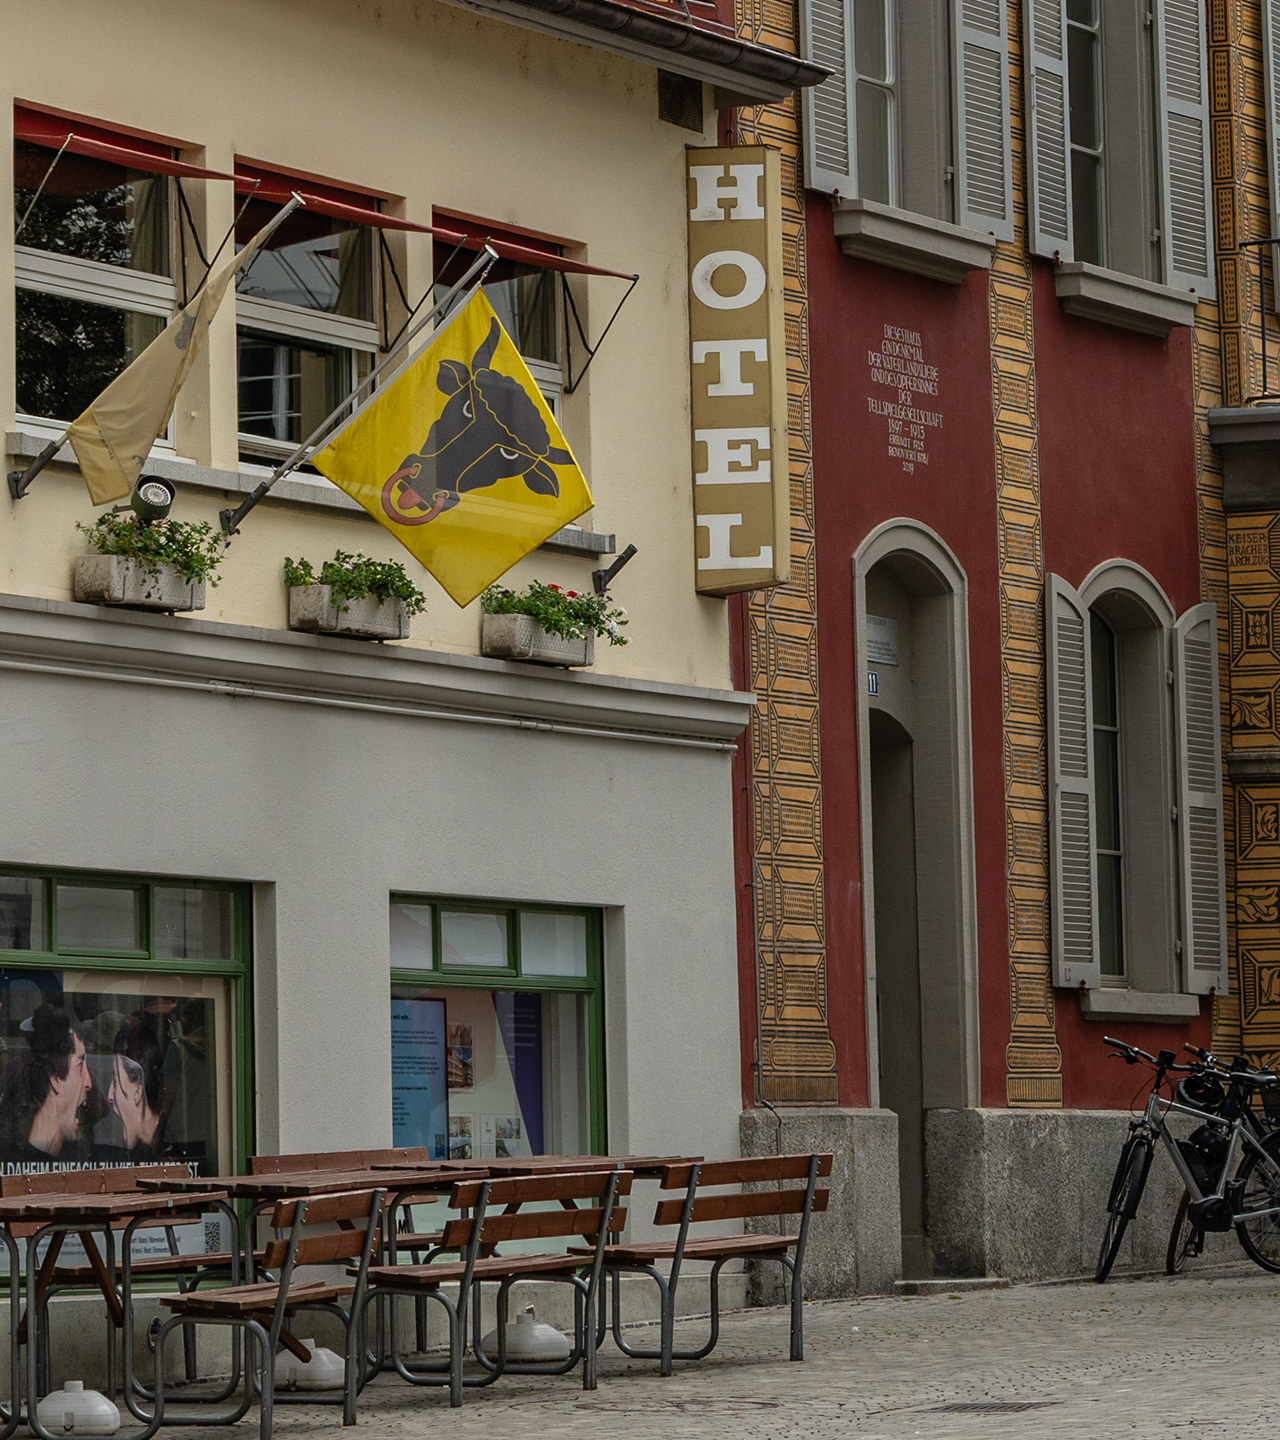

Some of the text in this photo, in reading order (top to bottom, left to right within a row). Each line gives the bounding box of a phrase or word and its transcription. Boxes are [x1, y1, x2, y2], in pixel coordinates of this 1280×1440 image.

[884, 324, 921, 347] DIESES HAUS
[881, 339, 924, 363] EIN DENKMAL
[688, 163, 773, 571] HOTEL
[868, 350, 939, 381] DER VATERLANDSLIEBE
[871, 367, 884, 384] UND
[884, 370, 897, 387] DES
[898, 389, 912, 406] DER
[1228, 544, 1268, 556] BRACHER
[868, 673, 877, 693] 11
